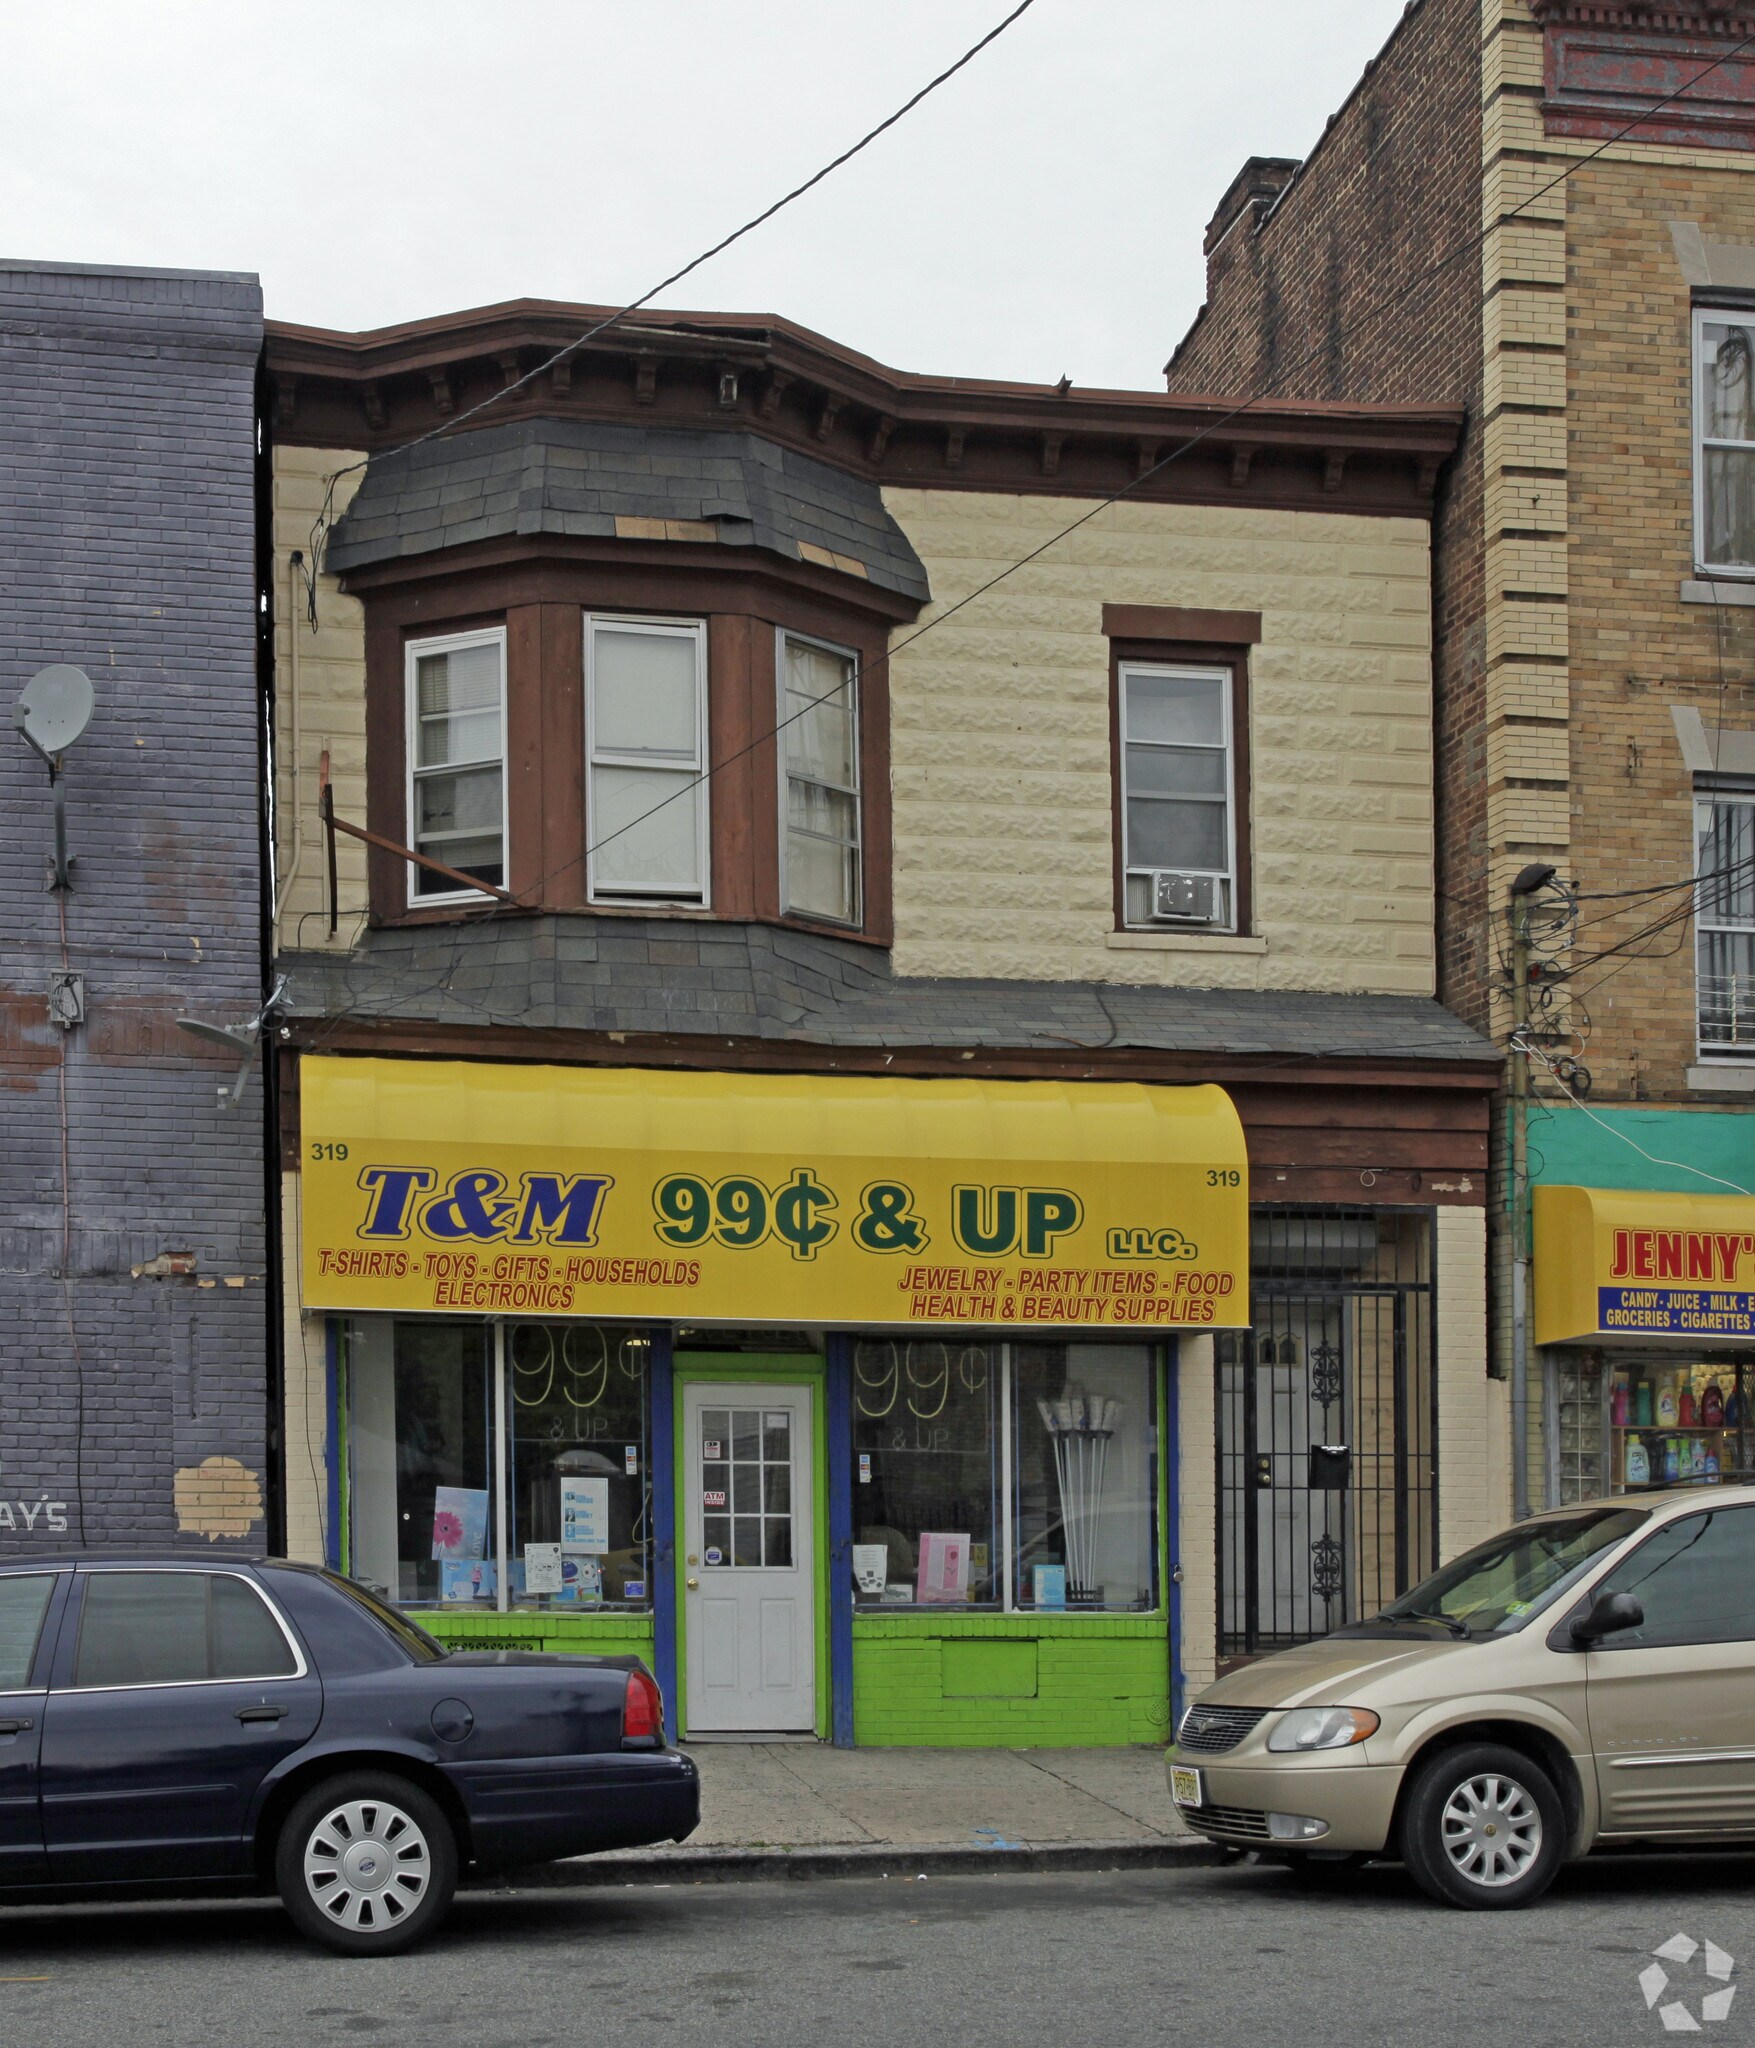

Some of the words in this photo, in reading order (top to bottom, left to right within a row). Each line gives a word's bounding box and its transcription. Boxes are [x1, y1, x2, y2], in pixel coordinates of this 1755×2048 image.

[311, 1143, 349, 1161] 319
[1206, 1170, 1241, 1187] 319
[357, 1165, 615, 1248] T&M
[652, 1168, 839, 1261] 99¢
[851, 1180, 931, 1255] &
[951, 1184, 1084, 1259] UP
[1106, 1227, 1198, 1261] LLC.
[319, 1249, 410, 1278] T-SHIRTS
[424, 1252, 478, 1281] TOYS
[492, 1255, 551, 1283] GIFTS
[564, 1256, 702, 1287] HOUSEHOLDS
[897, 1265, 1004, 1292] JEWELRY
[1017, 1268, 1090, 1294] PARTY
[1092, 1270, 1158, 1296] ITEMS
[1172, 1271, 1235, 1297] FOOD
[433, 1279, 575, 1310] ELECTRONICS
[909, 1292, 998, 1319] HEALTH
[1000, 1294, 1018, 1320] &
[1020, 1295, 1110, 1321] BEAUTY
[1111, 1297, 1217, 1323] SUPPLIES
[1621, 1291, 1658, 1308] CANDY
[1667, 1293, 1700, 1310] JUICE
[1710, 1294, 1738, 1311] MILK
[1606, 1309, 1671, 1327] GROCERIES
[1680, 1311, 1751, 1330] CIGARETTES
[705, 1492, 724, 1500] ATM
